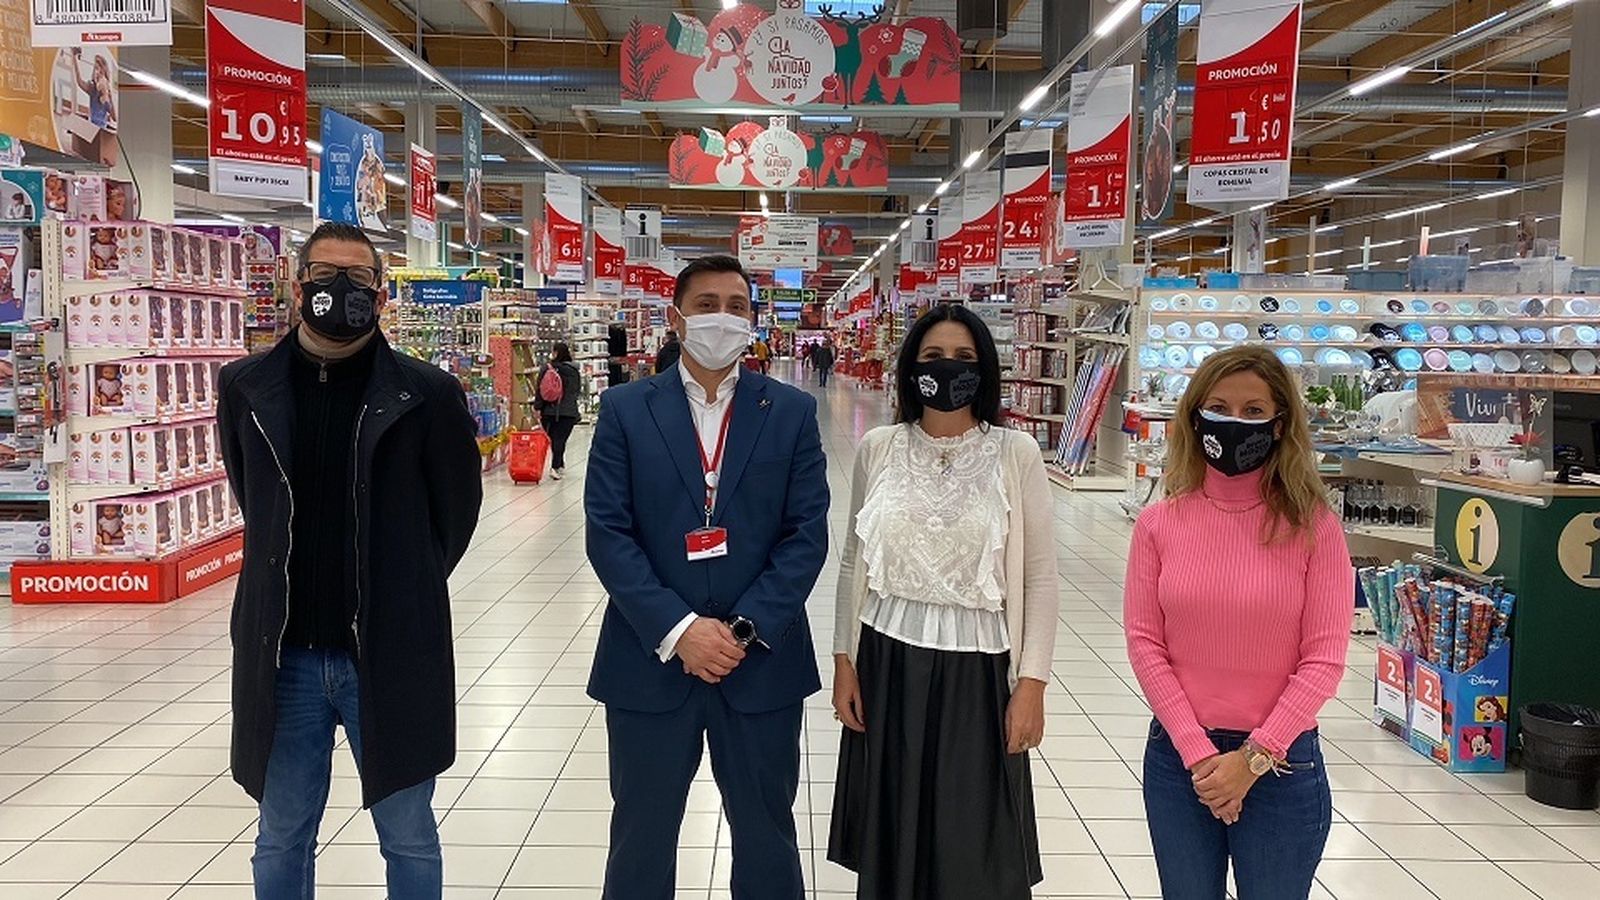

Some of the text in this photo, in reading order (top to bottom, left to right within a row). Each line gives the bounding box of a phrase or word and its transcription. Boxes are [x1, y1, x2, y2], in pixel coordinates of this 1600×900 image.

[784, 16, 829, 46] PASAMOS
[224, 66, 292, 85] PROMOCIÓN
[768, 60, 811, 76] NAVIDAD
[1208, 61, 1278, 81] PROMOCIÓN
[771, 77, 808, 89] JUNTOS?
[1229, 111, 1250, 144] 1
[1074, 152, 1118, 164] PROMOCIÓN
[1004, 220, 1033, 239] 24
[963, 243, 984, 260] 27
[939, 257, 957, 271] 29
[186, 558, 221, 582] PROMOCIÓN
[20, 570, 149, 593] PROMOCIÓN
[1467, 674, 1499, 688] Disney
